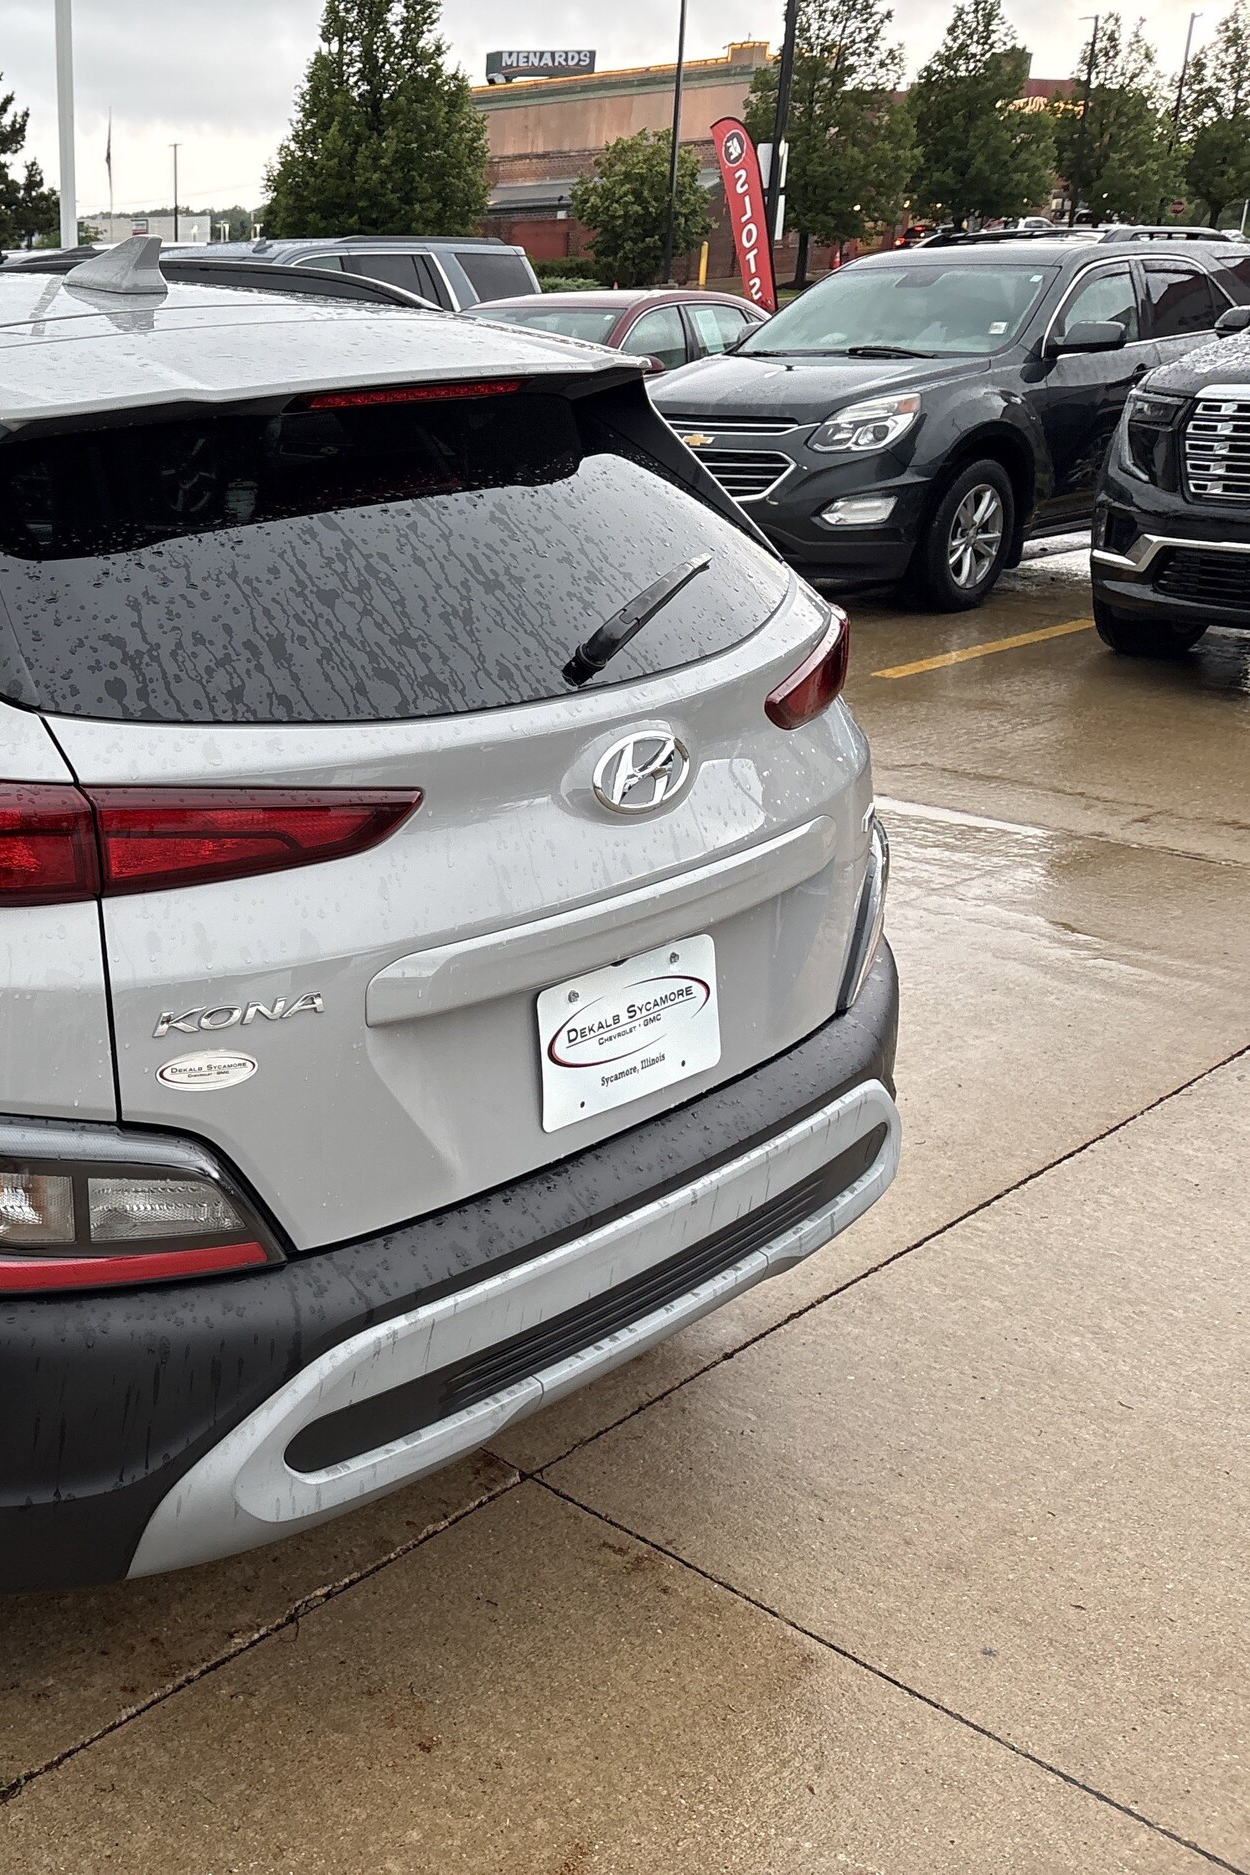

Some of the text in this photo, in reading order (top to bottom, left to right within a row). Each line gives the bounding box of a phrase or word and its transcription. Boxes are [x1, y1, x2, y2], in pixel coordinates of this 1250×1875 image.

[501, 51, 590, 67] MENARDS
[152, 991, 325, 1038] KONA
[626, 985, 694, 1019] SYCAMORE
[643, 1013, 662, 1027] GMC
[206, 1061, 248, 1072] SYCAMORE
[601, 1052, 666, 1087] Sycamore, Illinois
